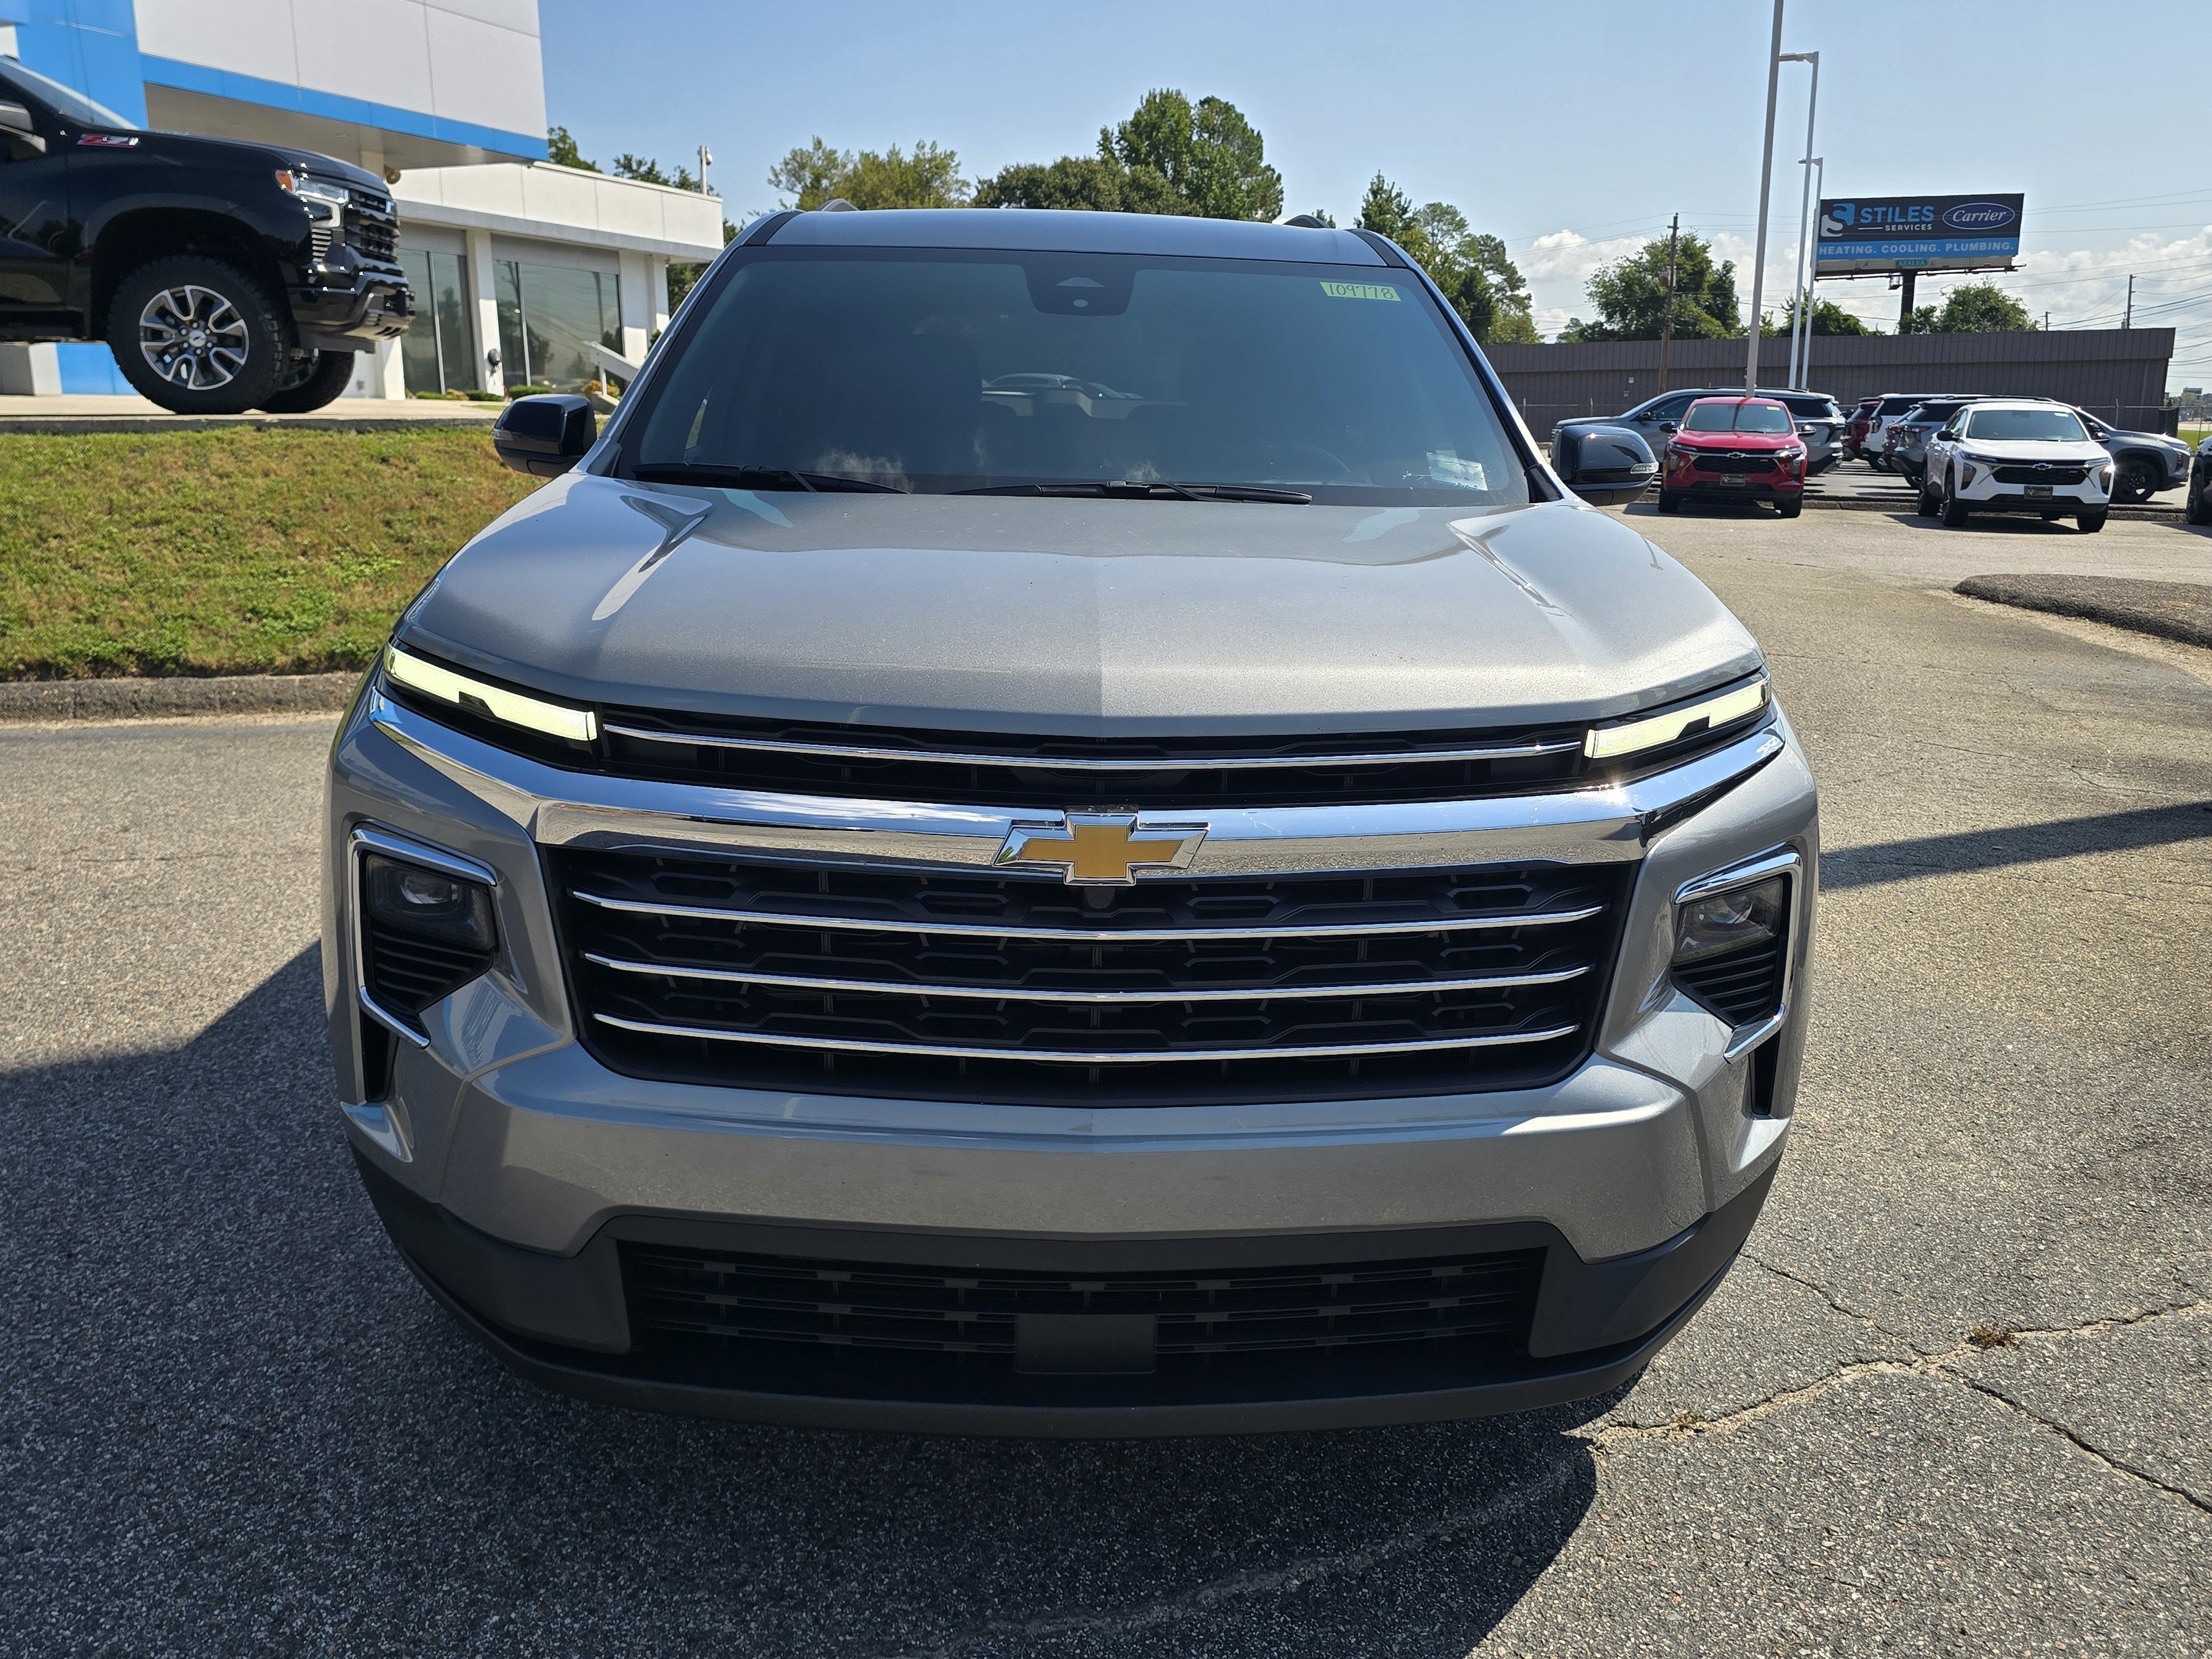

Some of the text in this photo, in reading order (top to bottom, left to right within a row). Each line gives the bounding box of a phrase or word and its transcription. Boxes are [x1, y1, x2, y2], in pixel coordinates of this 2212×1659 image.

[1860, 205, 1934, 223] STILES
[1952, 209, 2006, 222] Carrier
[1819, 242, 2014, 255] HEATING. COOLING. PLUMBING.
[1329, 284, 1394, 299] 109778
